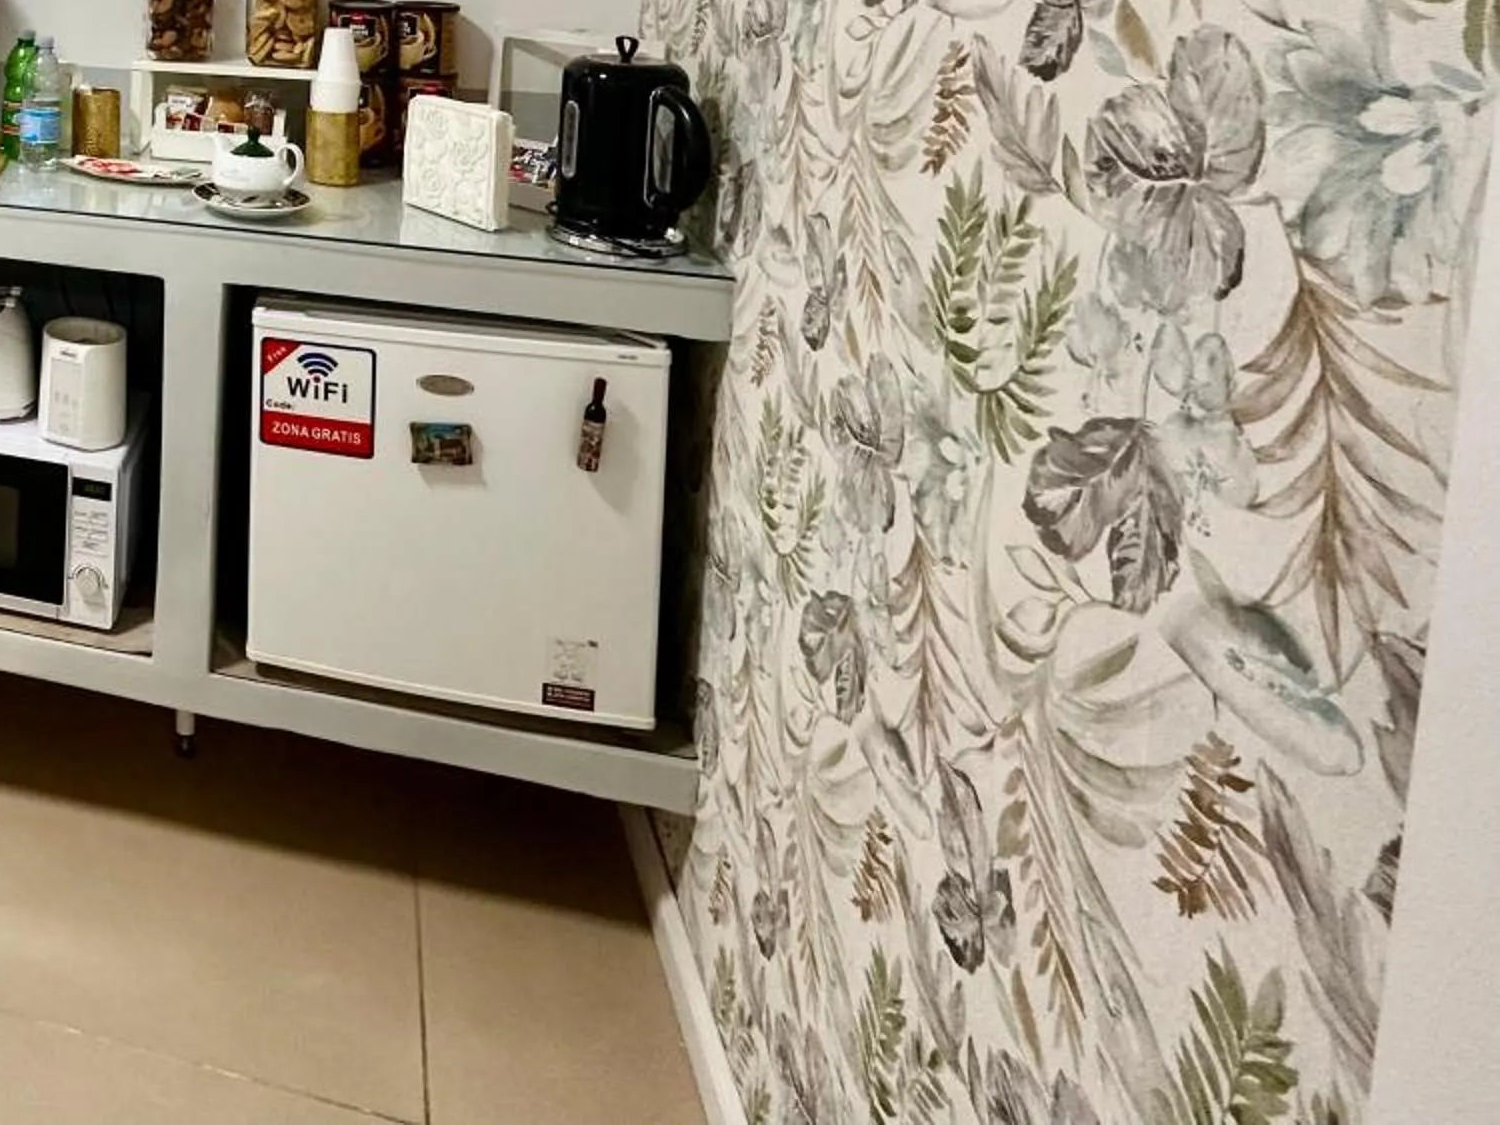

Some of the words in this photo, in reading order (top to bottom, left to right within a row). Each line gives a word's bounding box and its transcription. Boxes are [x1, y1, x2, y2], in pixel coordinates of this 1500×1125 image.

[287, 376, 348, 403] WiFi
[272, 421, 310, 437] ZONA
[311, 427, 361, 444] GRATIS
